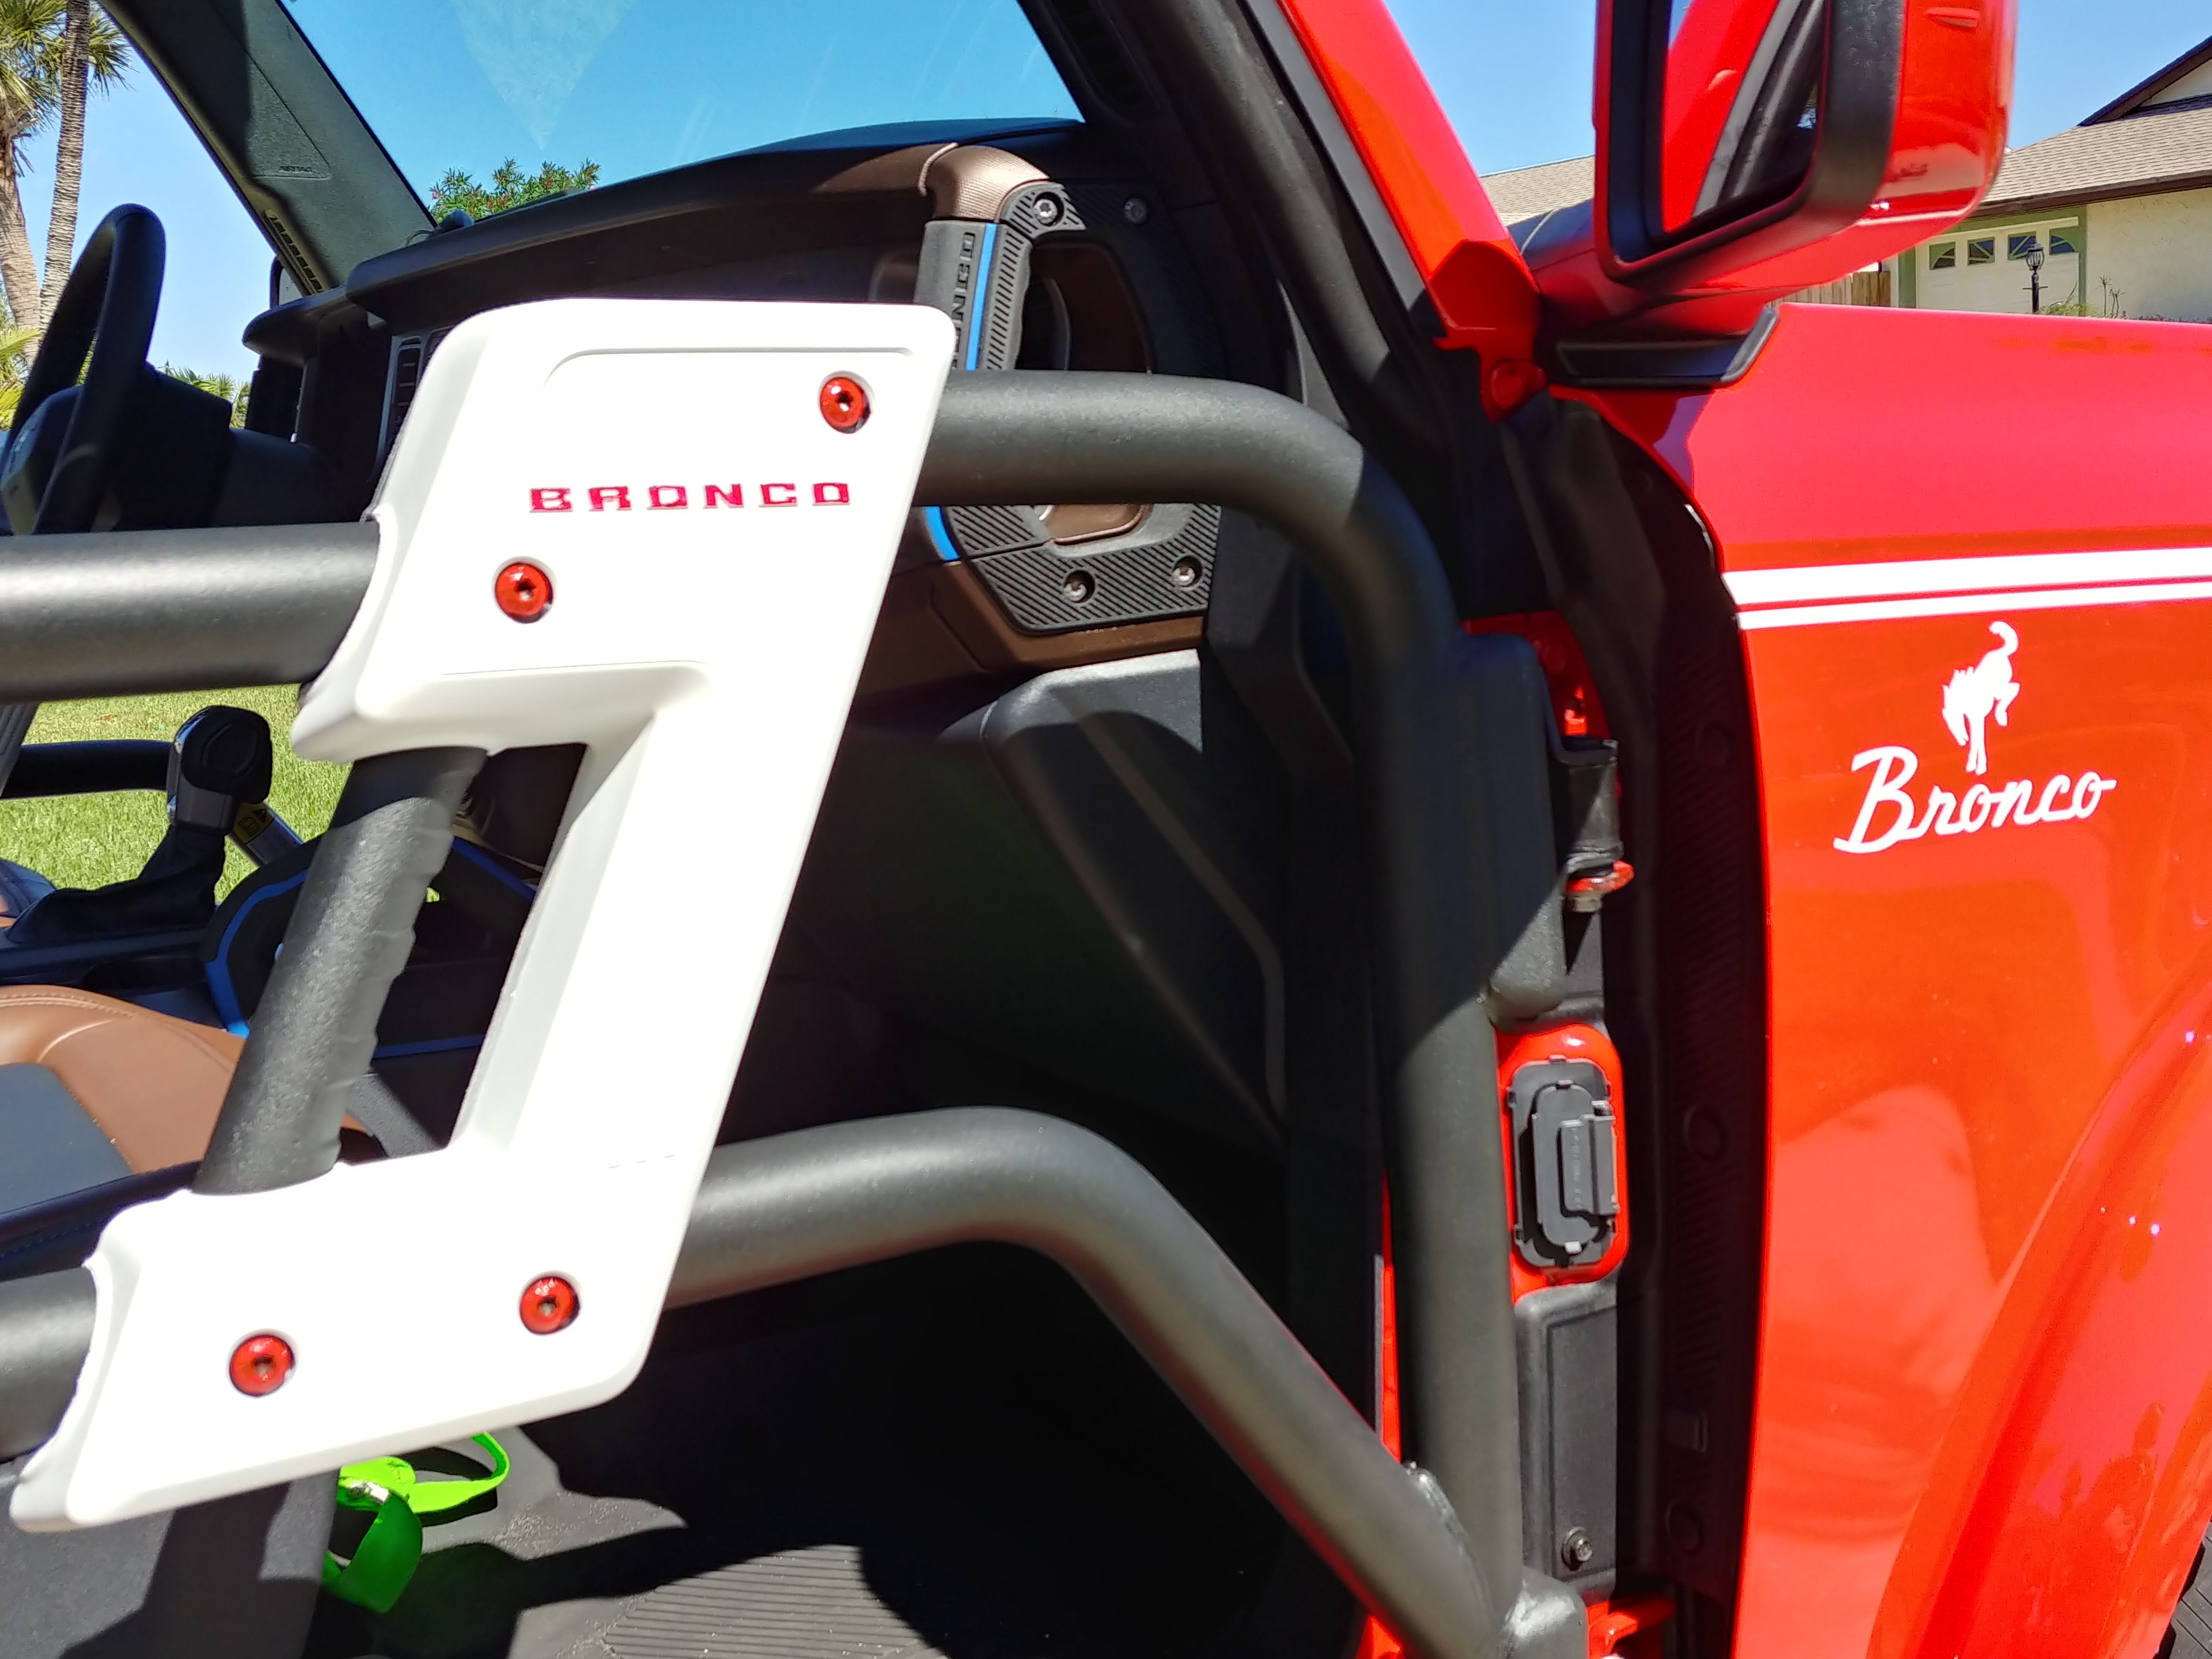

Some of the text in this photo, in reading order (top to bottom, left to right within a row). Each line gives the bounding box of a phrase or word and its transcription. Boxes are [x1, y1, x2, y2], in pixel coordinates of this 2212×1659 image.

[951, 231, 976, 370] NCO
[529, 483, 850, 513] BRONCO
[1833, 745, 2117, 854] Bronco
